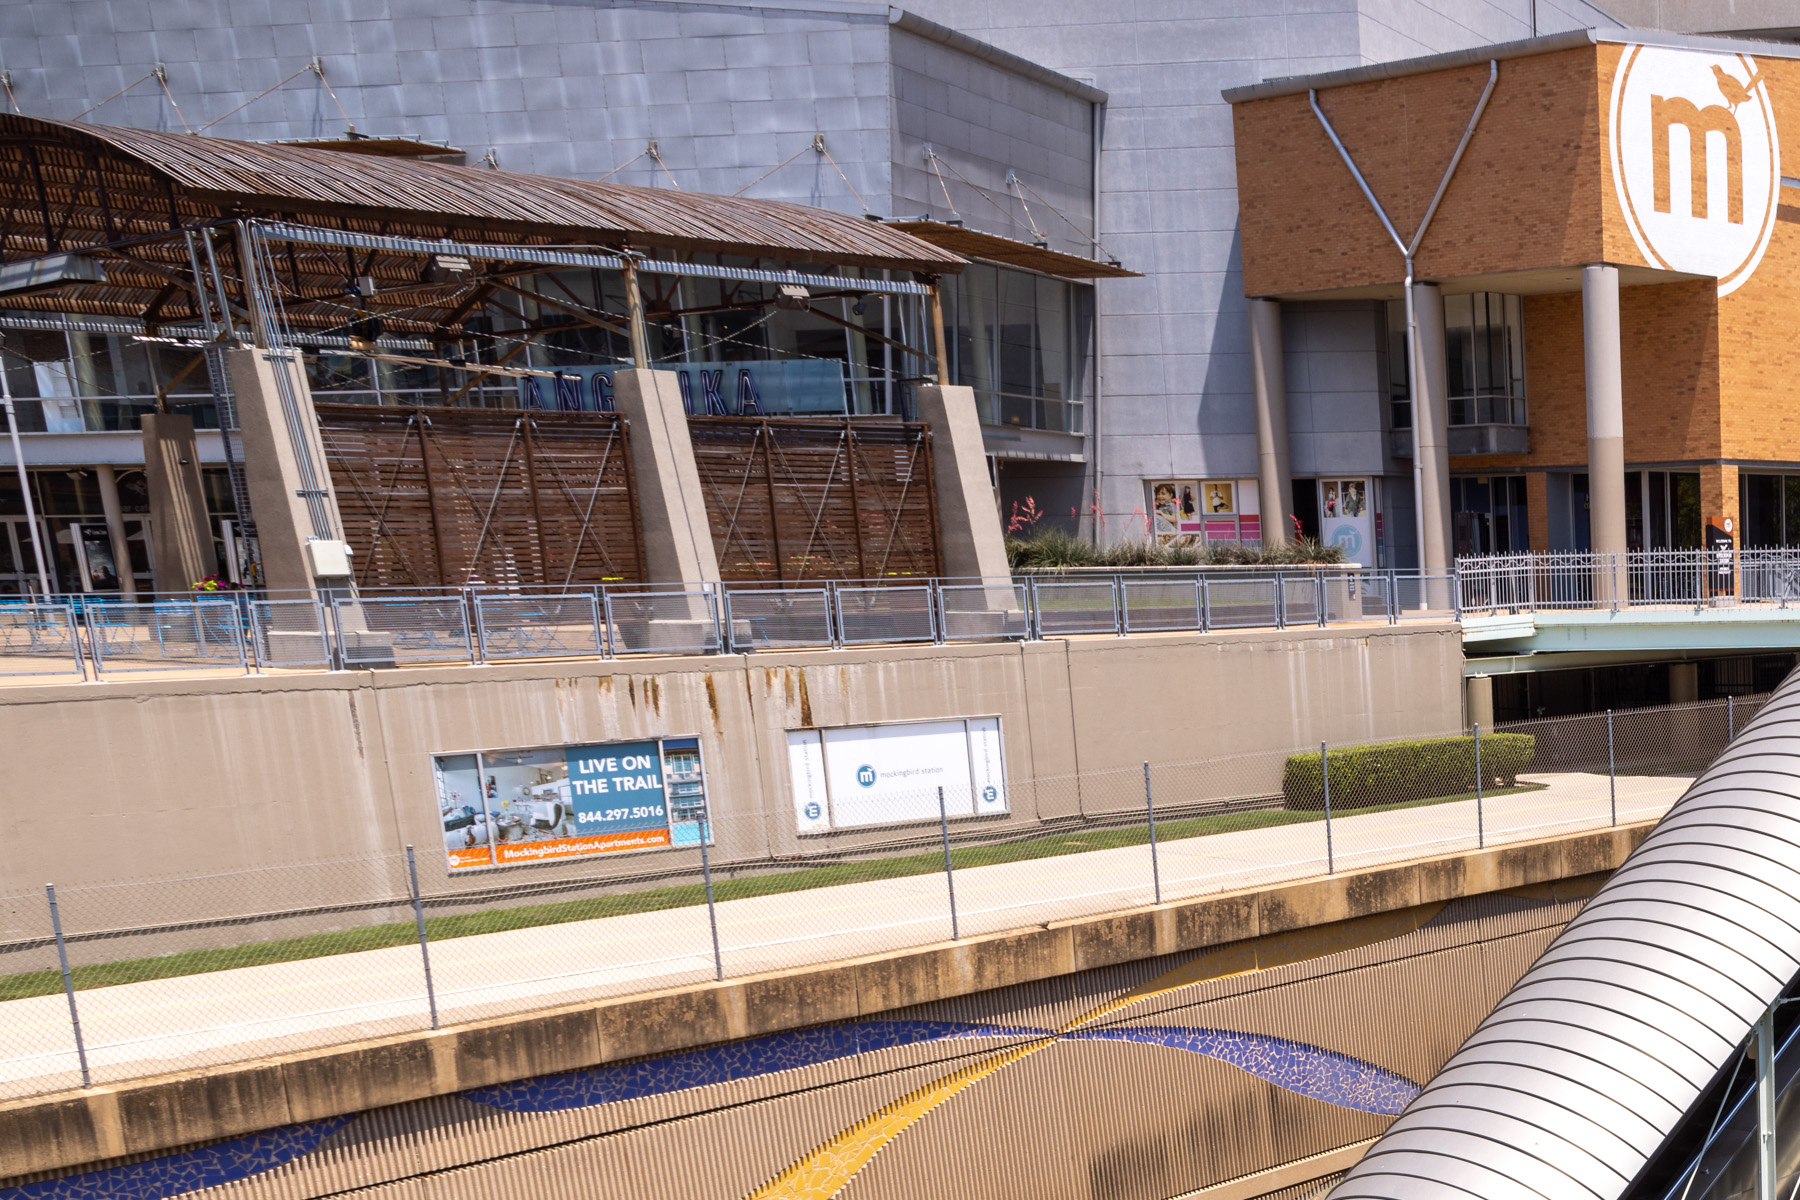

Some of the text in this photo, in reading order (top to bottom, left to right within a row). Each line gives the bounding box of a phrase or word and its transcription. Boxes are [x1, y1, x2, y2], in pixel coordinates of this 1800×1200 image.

[522, 368, 765, 417] ANGIKA
[579, 755, 651, 774] LIVE ON
[880, 767, 944, 778] mockingbird station
[572, 774, 662, 795] THE TRAIL
[578, 804, 664, 824] 844.297.5016
[503, 835, 665, 859] MockingbirdStationApartments.com
